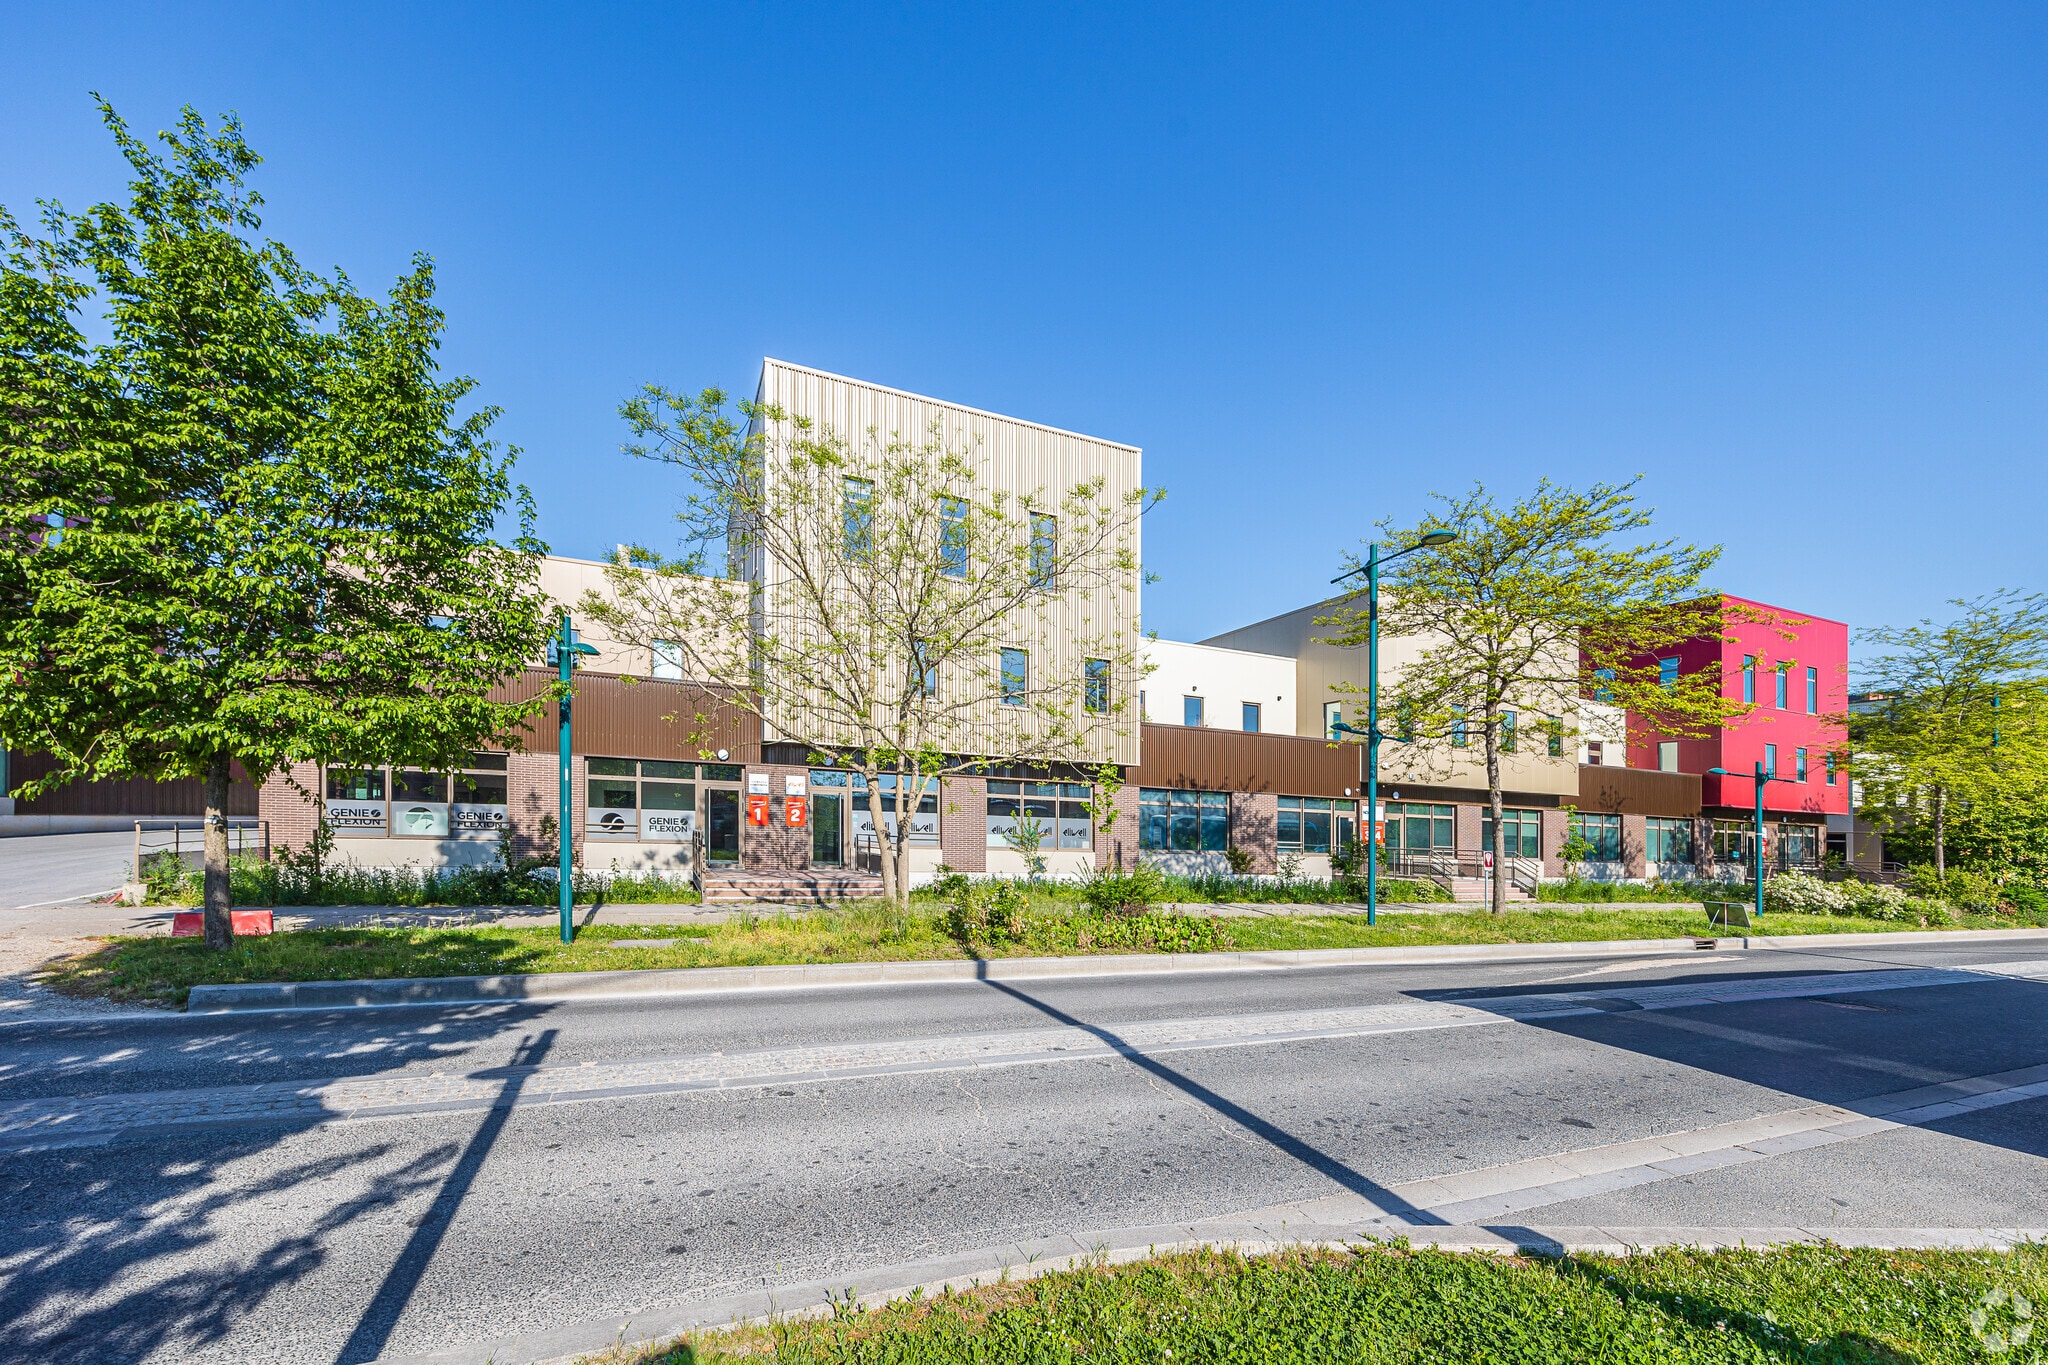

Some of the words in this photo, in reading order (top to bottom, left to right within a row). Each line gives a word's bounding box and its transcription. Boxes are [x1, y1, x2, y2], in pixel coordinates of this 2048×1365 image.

[330, 808, 370, 817] GENIE
[457, 812, 492, 820] GENIE
[754, 808, 761, 821] 1
[790, 809, 800, 822] 2
[649, 817, 679, 825] GENIE
[1063, 827, 1087, 837] eliwell
